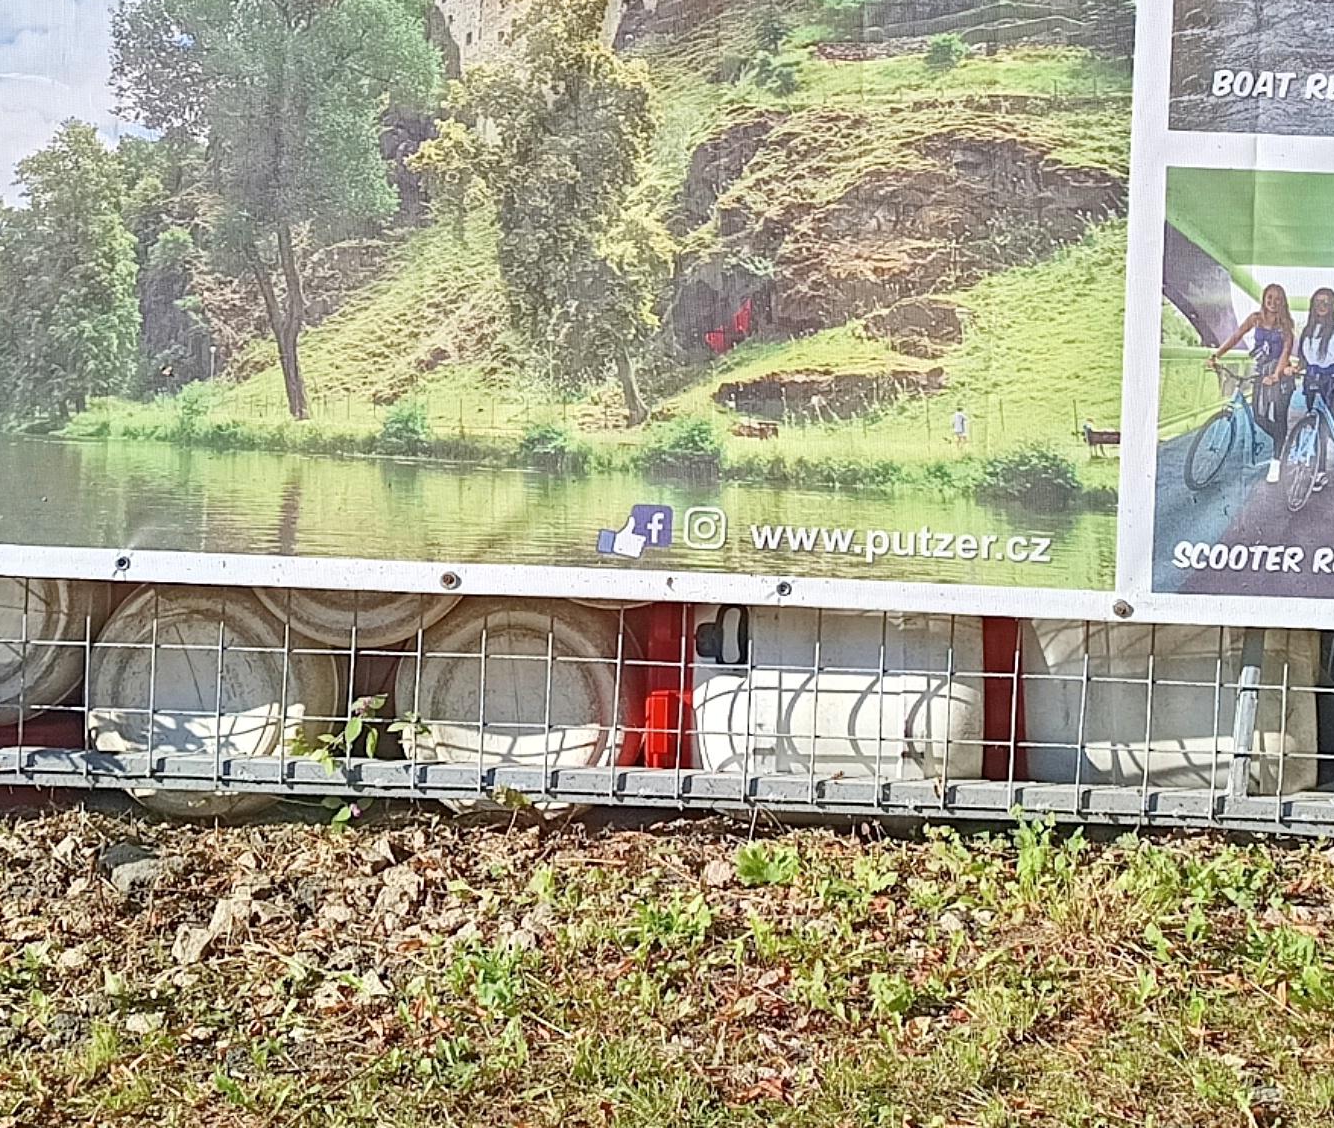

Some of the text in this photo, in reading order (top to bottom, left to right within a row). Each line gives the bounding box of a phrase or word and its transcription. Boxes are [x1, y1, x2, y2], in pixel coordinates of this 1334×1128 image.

[1212, 69, 1298, 99] BOAT
[749, 520, 1053, 564] www.putzer.cz
[1172, 540, 1305, 573] SCOOTER
